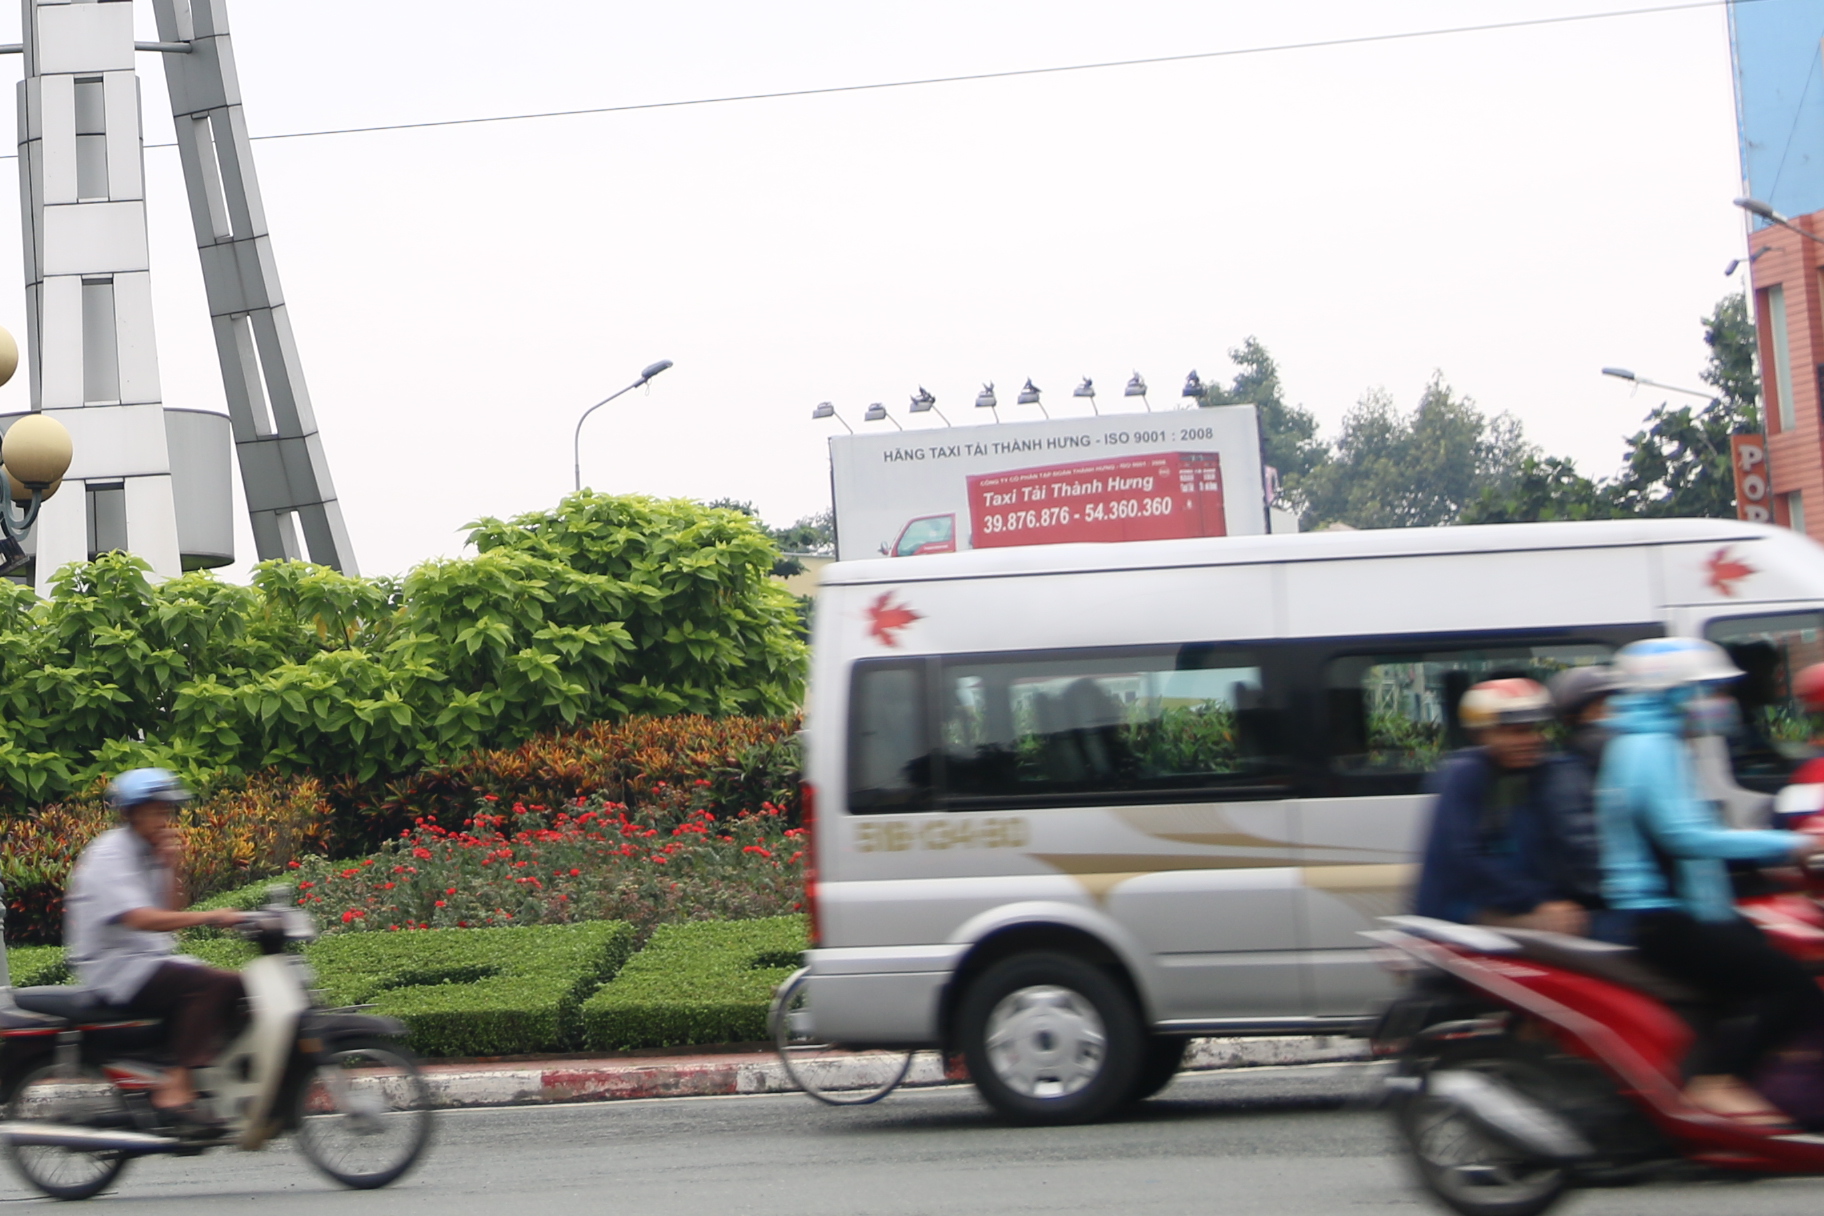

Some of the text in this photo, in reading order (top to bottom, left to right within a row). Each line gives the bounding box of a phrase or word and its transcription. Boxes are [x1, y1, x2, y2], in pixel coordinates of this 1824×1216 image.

[929, 445, 961, 459] TAXI
[992, 438, 1043, 454] THÀNH
[1047, 434, 1091, 450] HƯNG
[1104, 432, 1130, 445] ISO
[1134, 431, 1166, 444] 9001
[1180, 427, 1214, 441] 2008
[983, 475, 1154, 507] Taxi Tải Thành Hưng
[983, 507, 1069, 534] 39.876.876
[1084, 496, 1172, 522] 54.360.360
